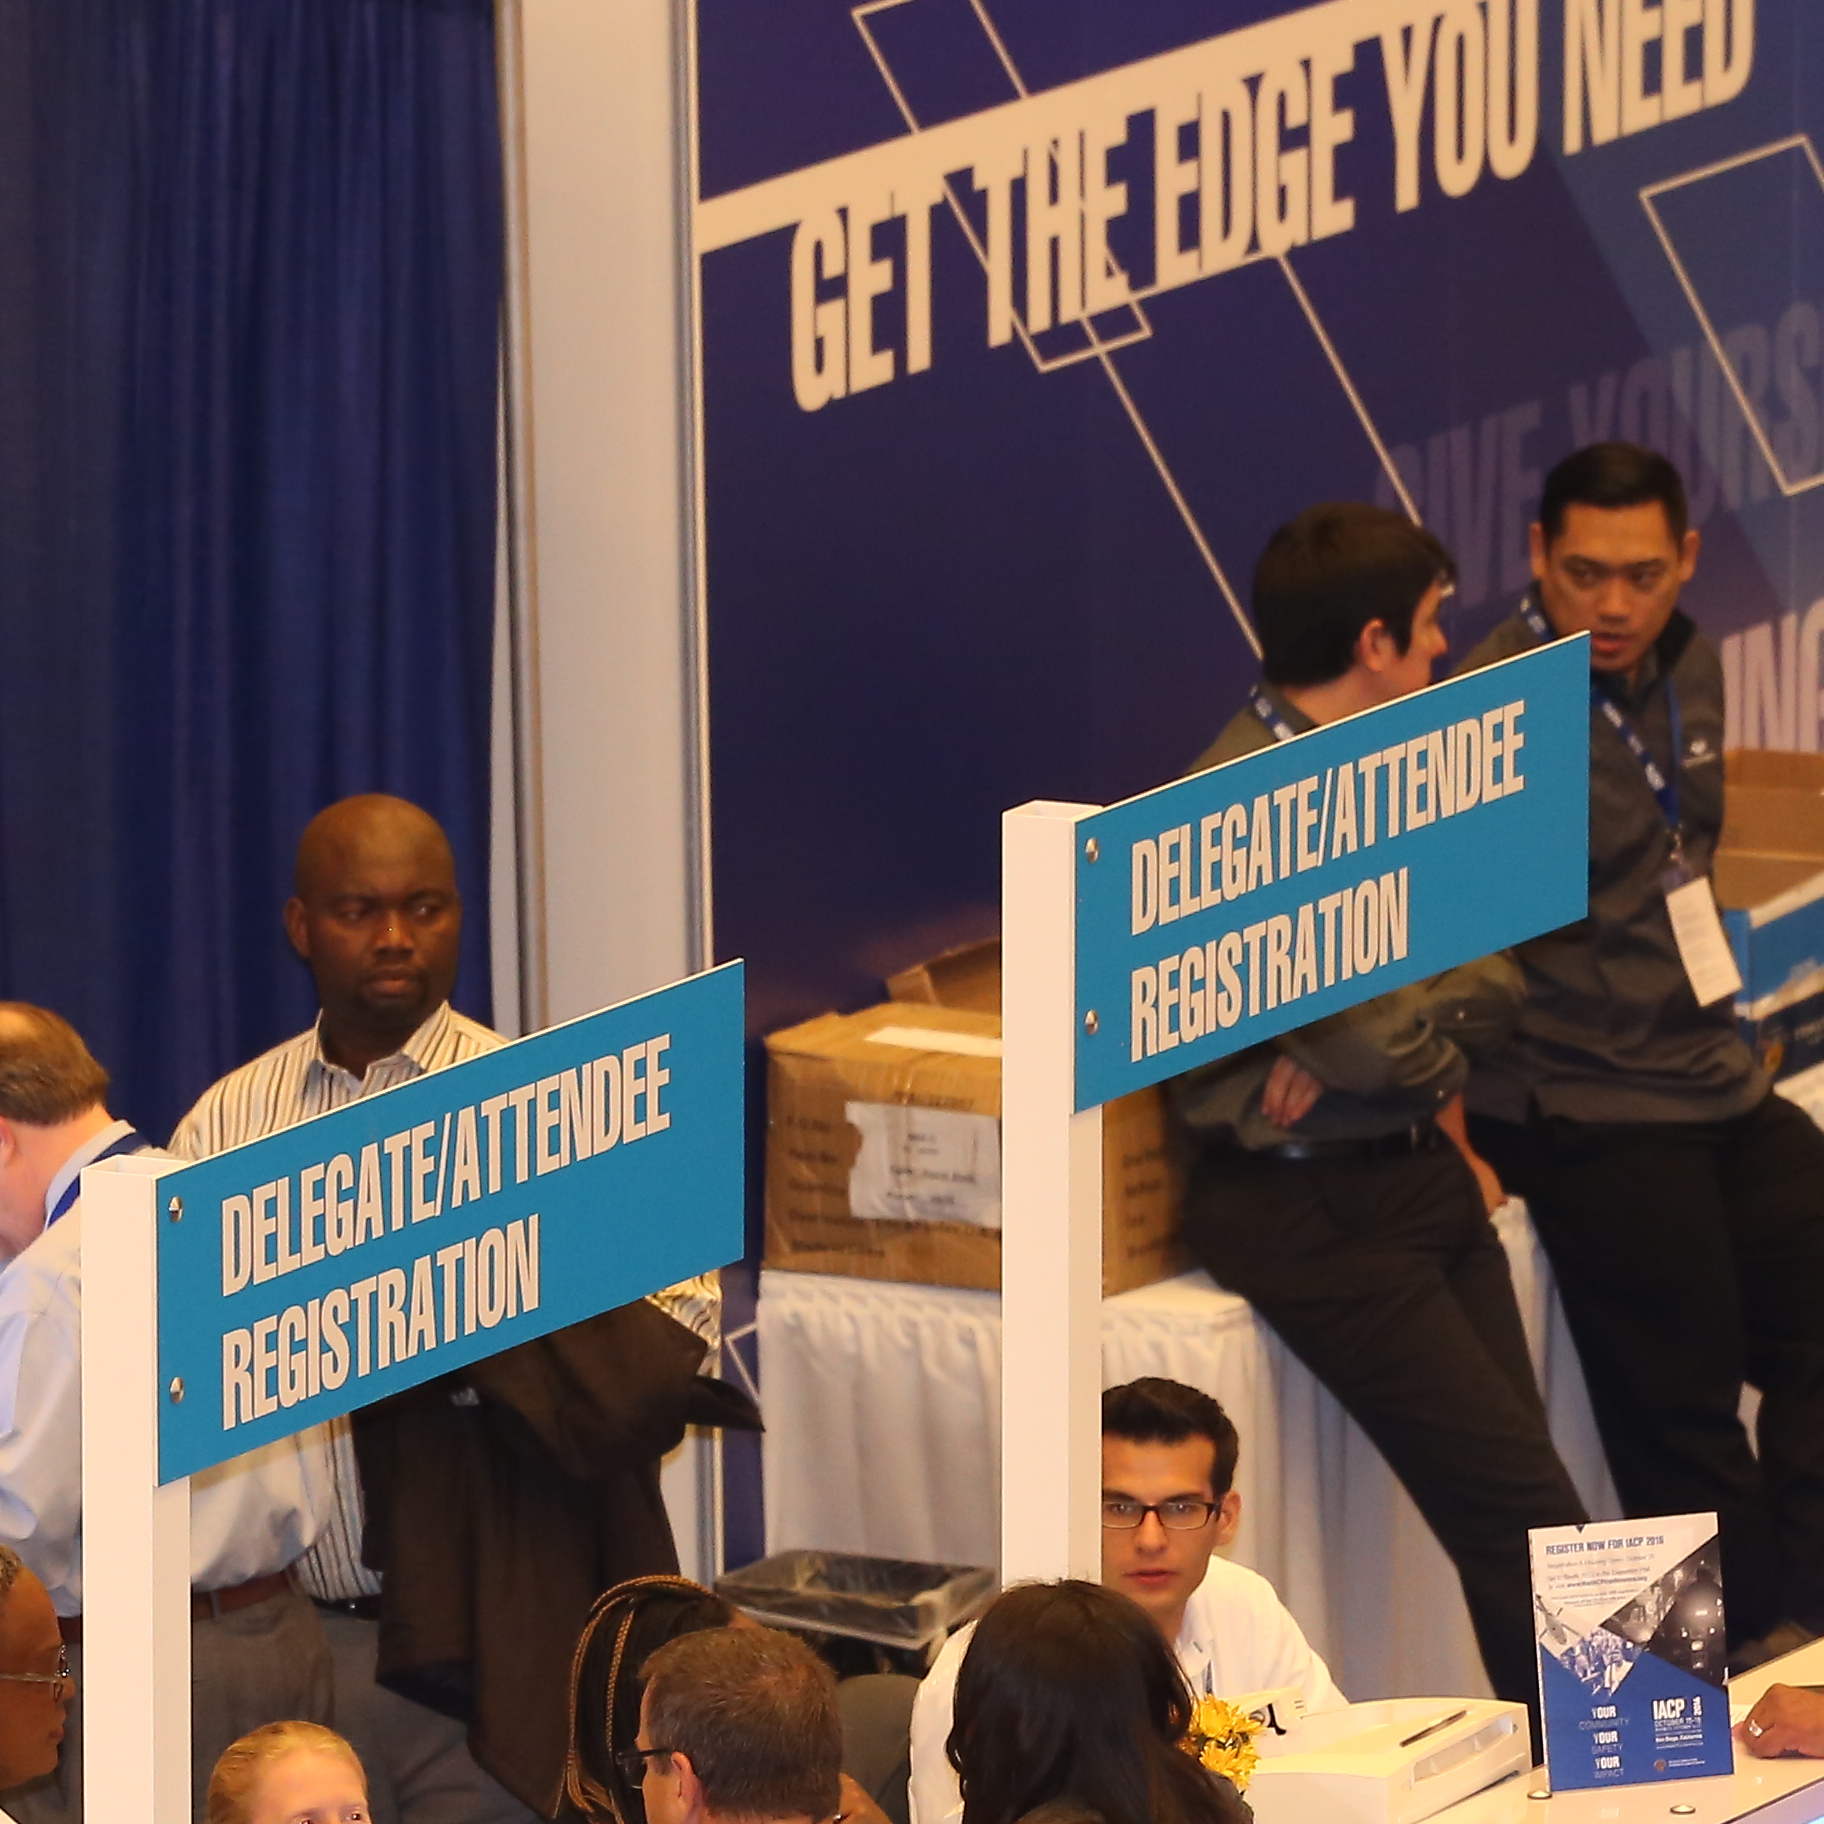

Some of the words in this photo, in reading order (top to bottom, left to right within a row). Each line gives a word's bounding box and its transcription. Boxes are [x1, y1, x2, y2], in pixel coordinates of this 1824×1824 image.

[790, 192, 943, 411] GET
[976, 125, 1128, 347] THE
[1156, 56, 1353, 286] EDGE
[1379, 0, 1538, 212] YOU
[1131, 700, 1524, 936] DELEGATE/ATTENDEE
[1131, 867, 1408, 1062] REGISTRATION
[221, 1033, 671, 1297] DELEGATE/ATTENDEE
[222, 1214, 540, 1432] REGISTRATION
[1546, 1541, 1584, 1555] REGISTER
[1587, 1540, 1605, 1550] NOW
[1608, 1538, 1624, 1549] FOR
[1626, 1537, 1644, 1547] IACP
[1592, 1706, 1617, 1719] YOUR
[1593, 1731, 1618, 1744] YOUR
[1595, 1756, 1620, 1769] YOUR
[1653, 1699, 1685, 1720] IACP
